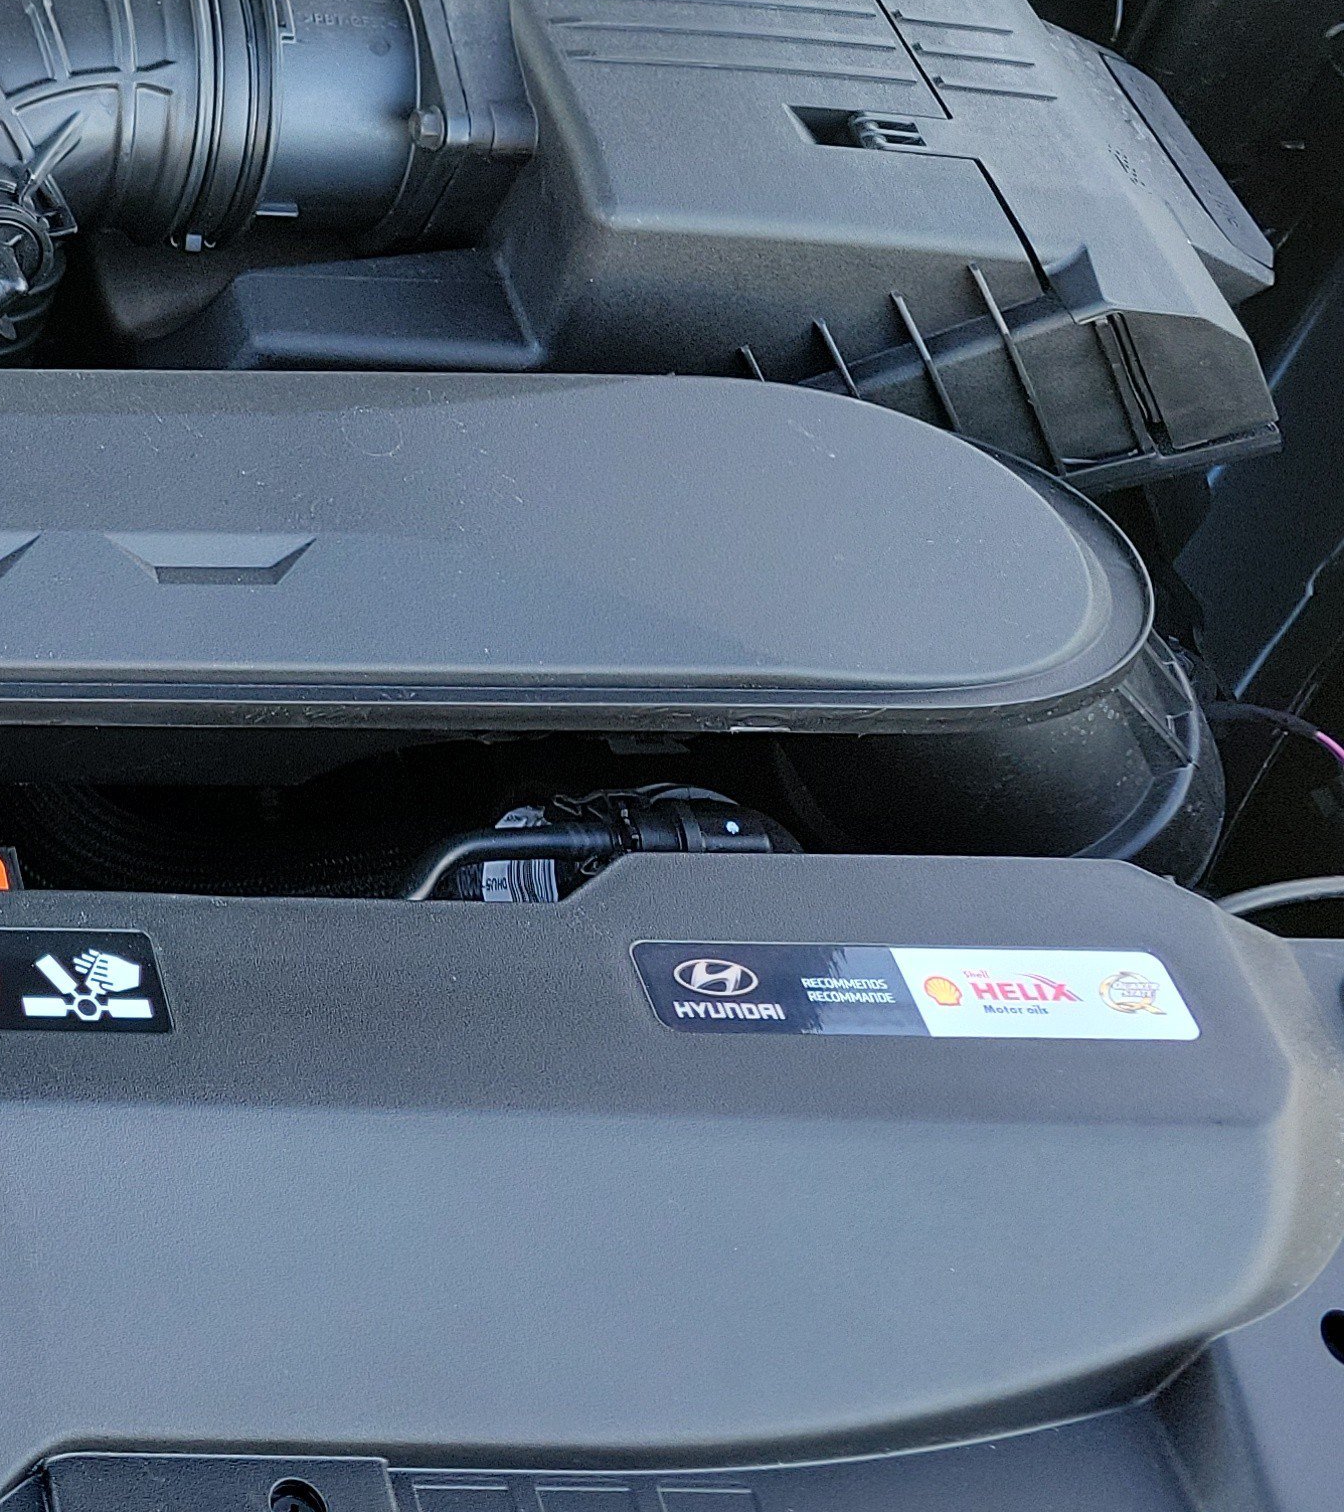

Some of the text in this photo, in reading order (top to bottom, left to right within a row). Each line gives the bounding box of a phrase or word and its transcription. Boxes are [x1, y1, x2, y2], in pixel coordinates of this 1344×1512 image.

[962, 969, 990, 979] Shell
[800, 976, 889, 991] RECOMMENDS
[969, 980, 1080, 1002] HELIX
[807, 990, 897, 1005] RECOMMANDE
[672, 1001, 787, 1021] HYUNDAI
[983, 1004, 1050, 1015] Motor oils
